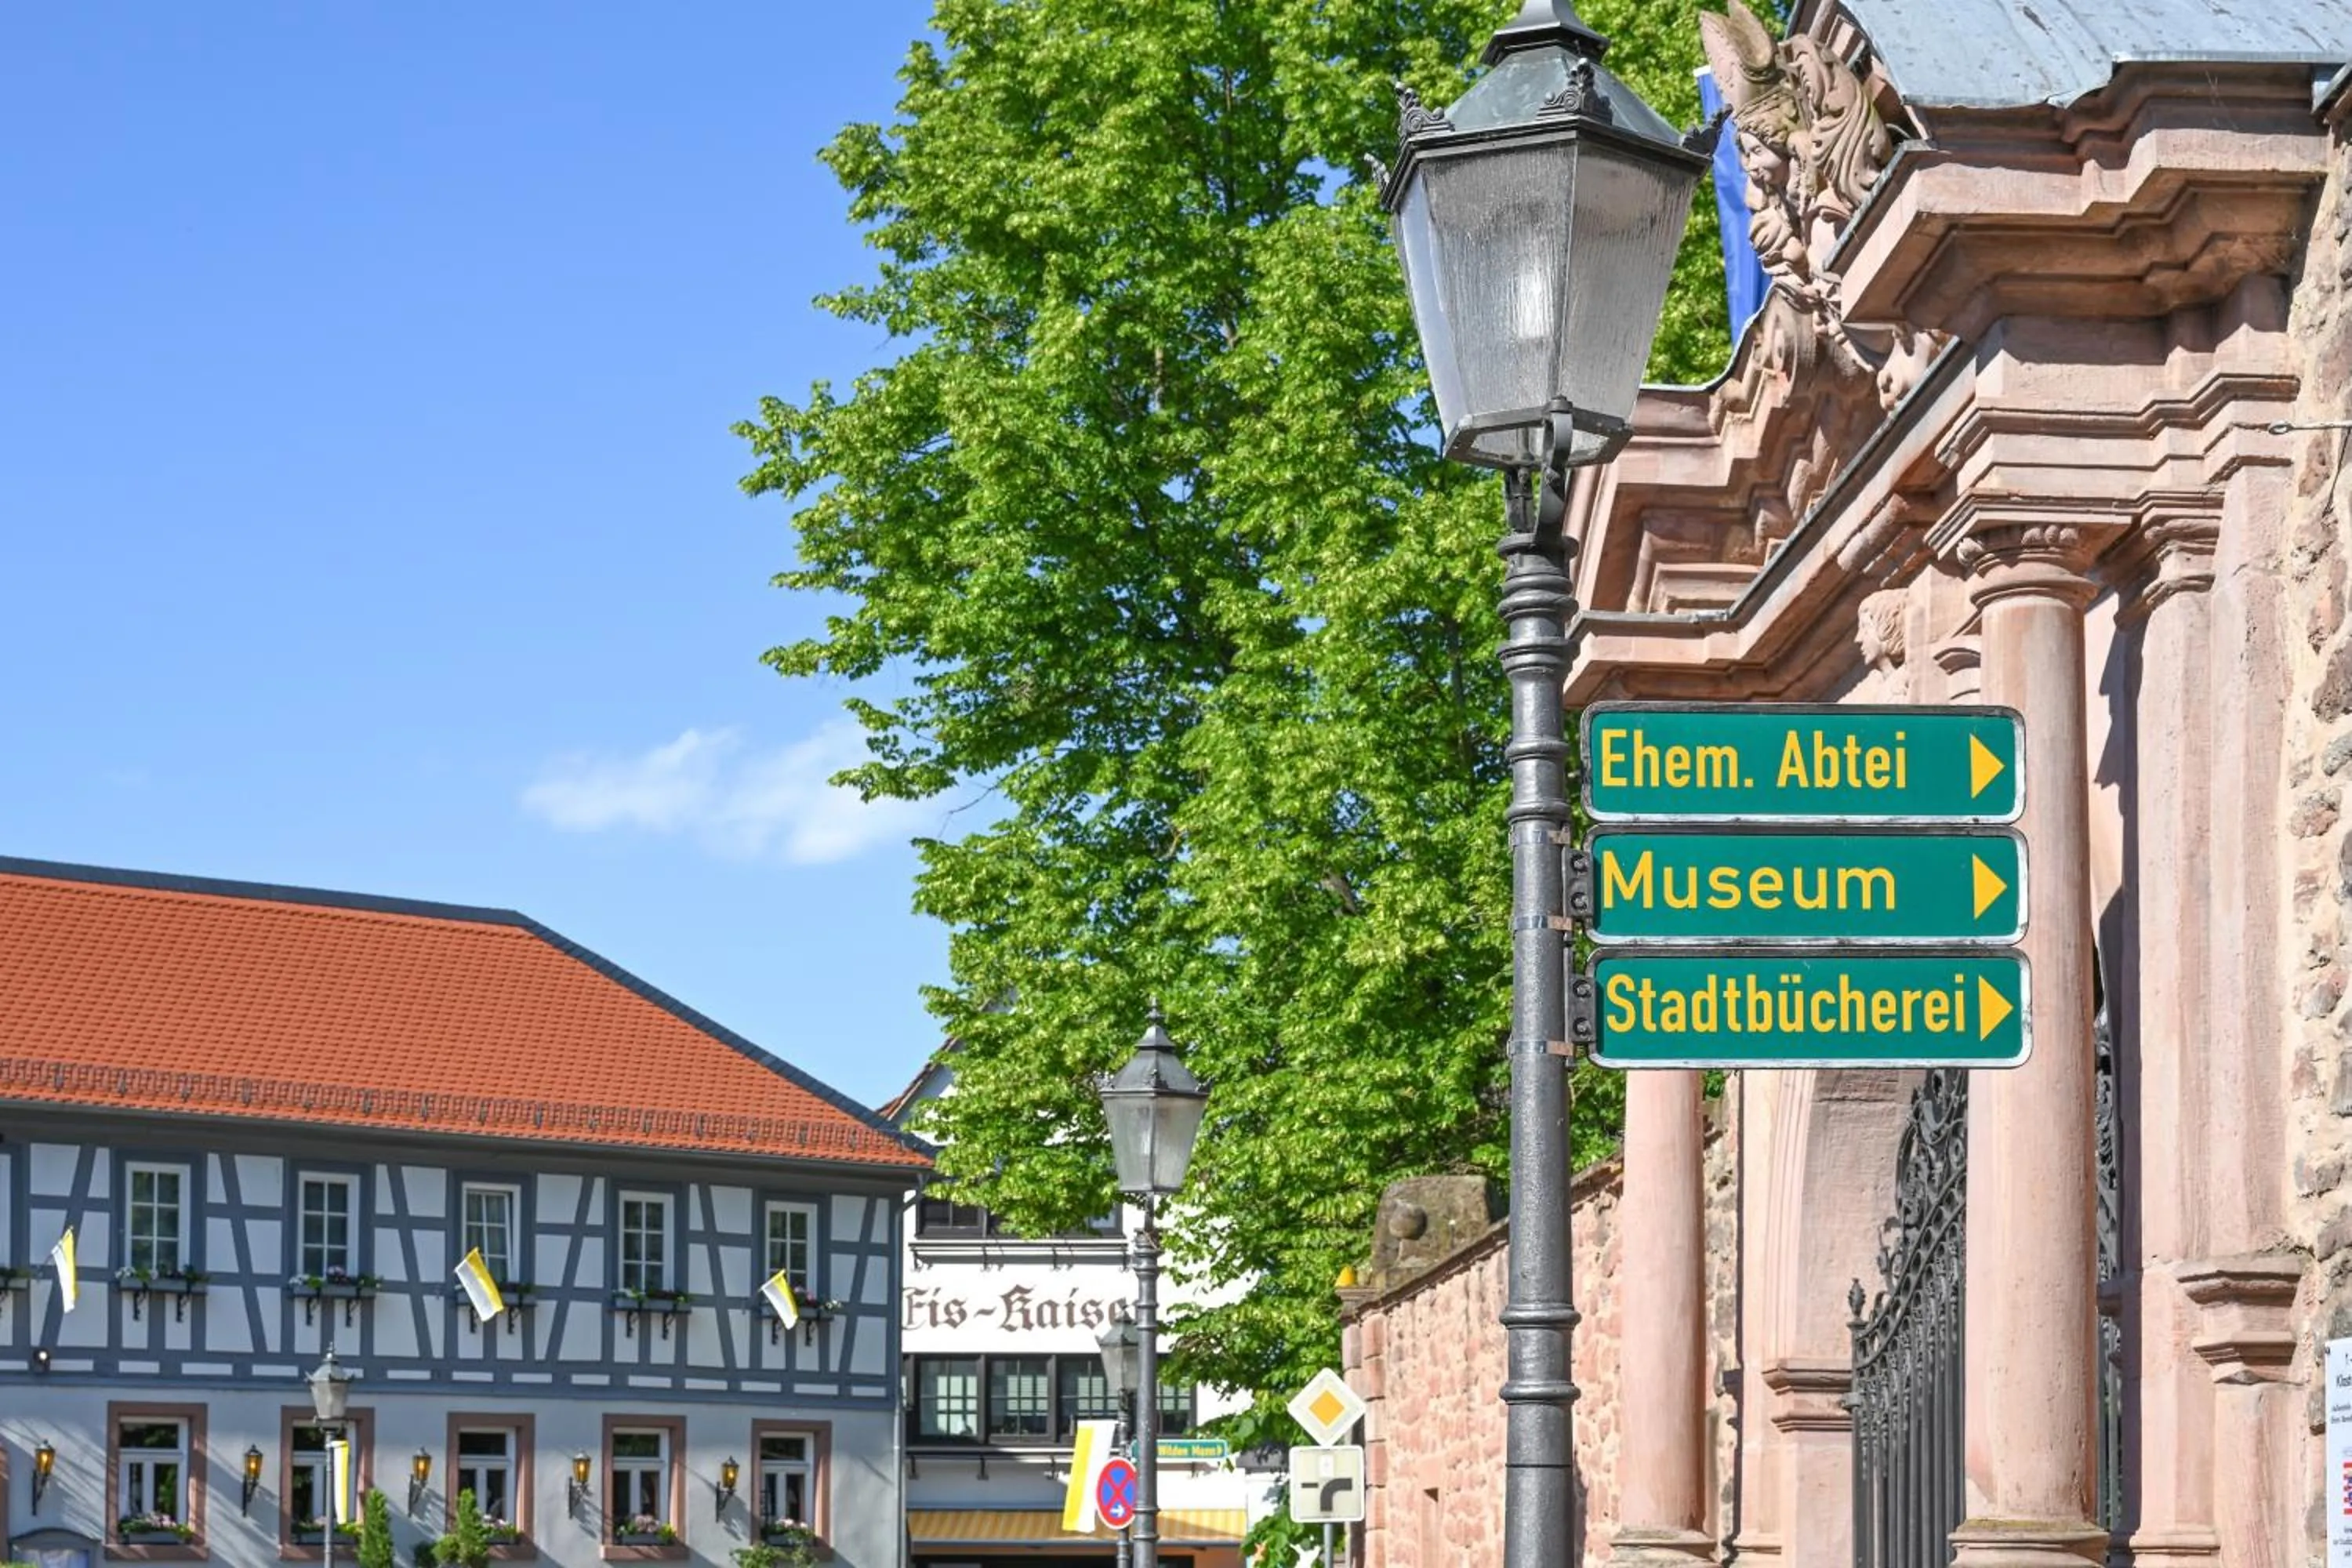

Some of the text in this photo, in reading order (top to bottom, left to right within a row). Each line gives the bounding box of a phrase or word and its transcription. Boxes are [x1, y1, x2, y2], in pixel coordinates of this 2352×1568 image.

[1601, 728, 1907, 788] Ehem. Abtei
[1602, 851, 1896, 909] Museum
[1606, 974, 1965, 1033] Stadtbücherei
[902, 1284, 1138, 1332] Eis-Kaise
